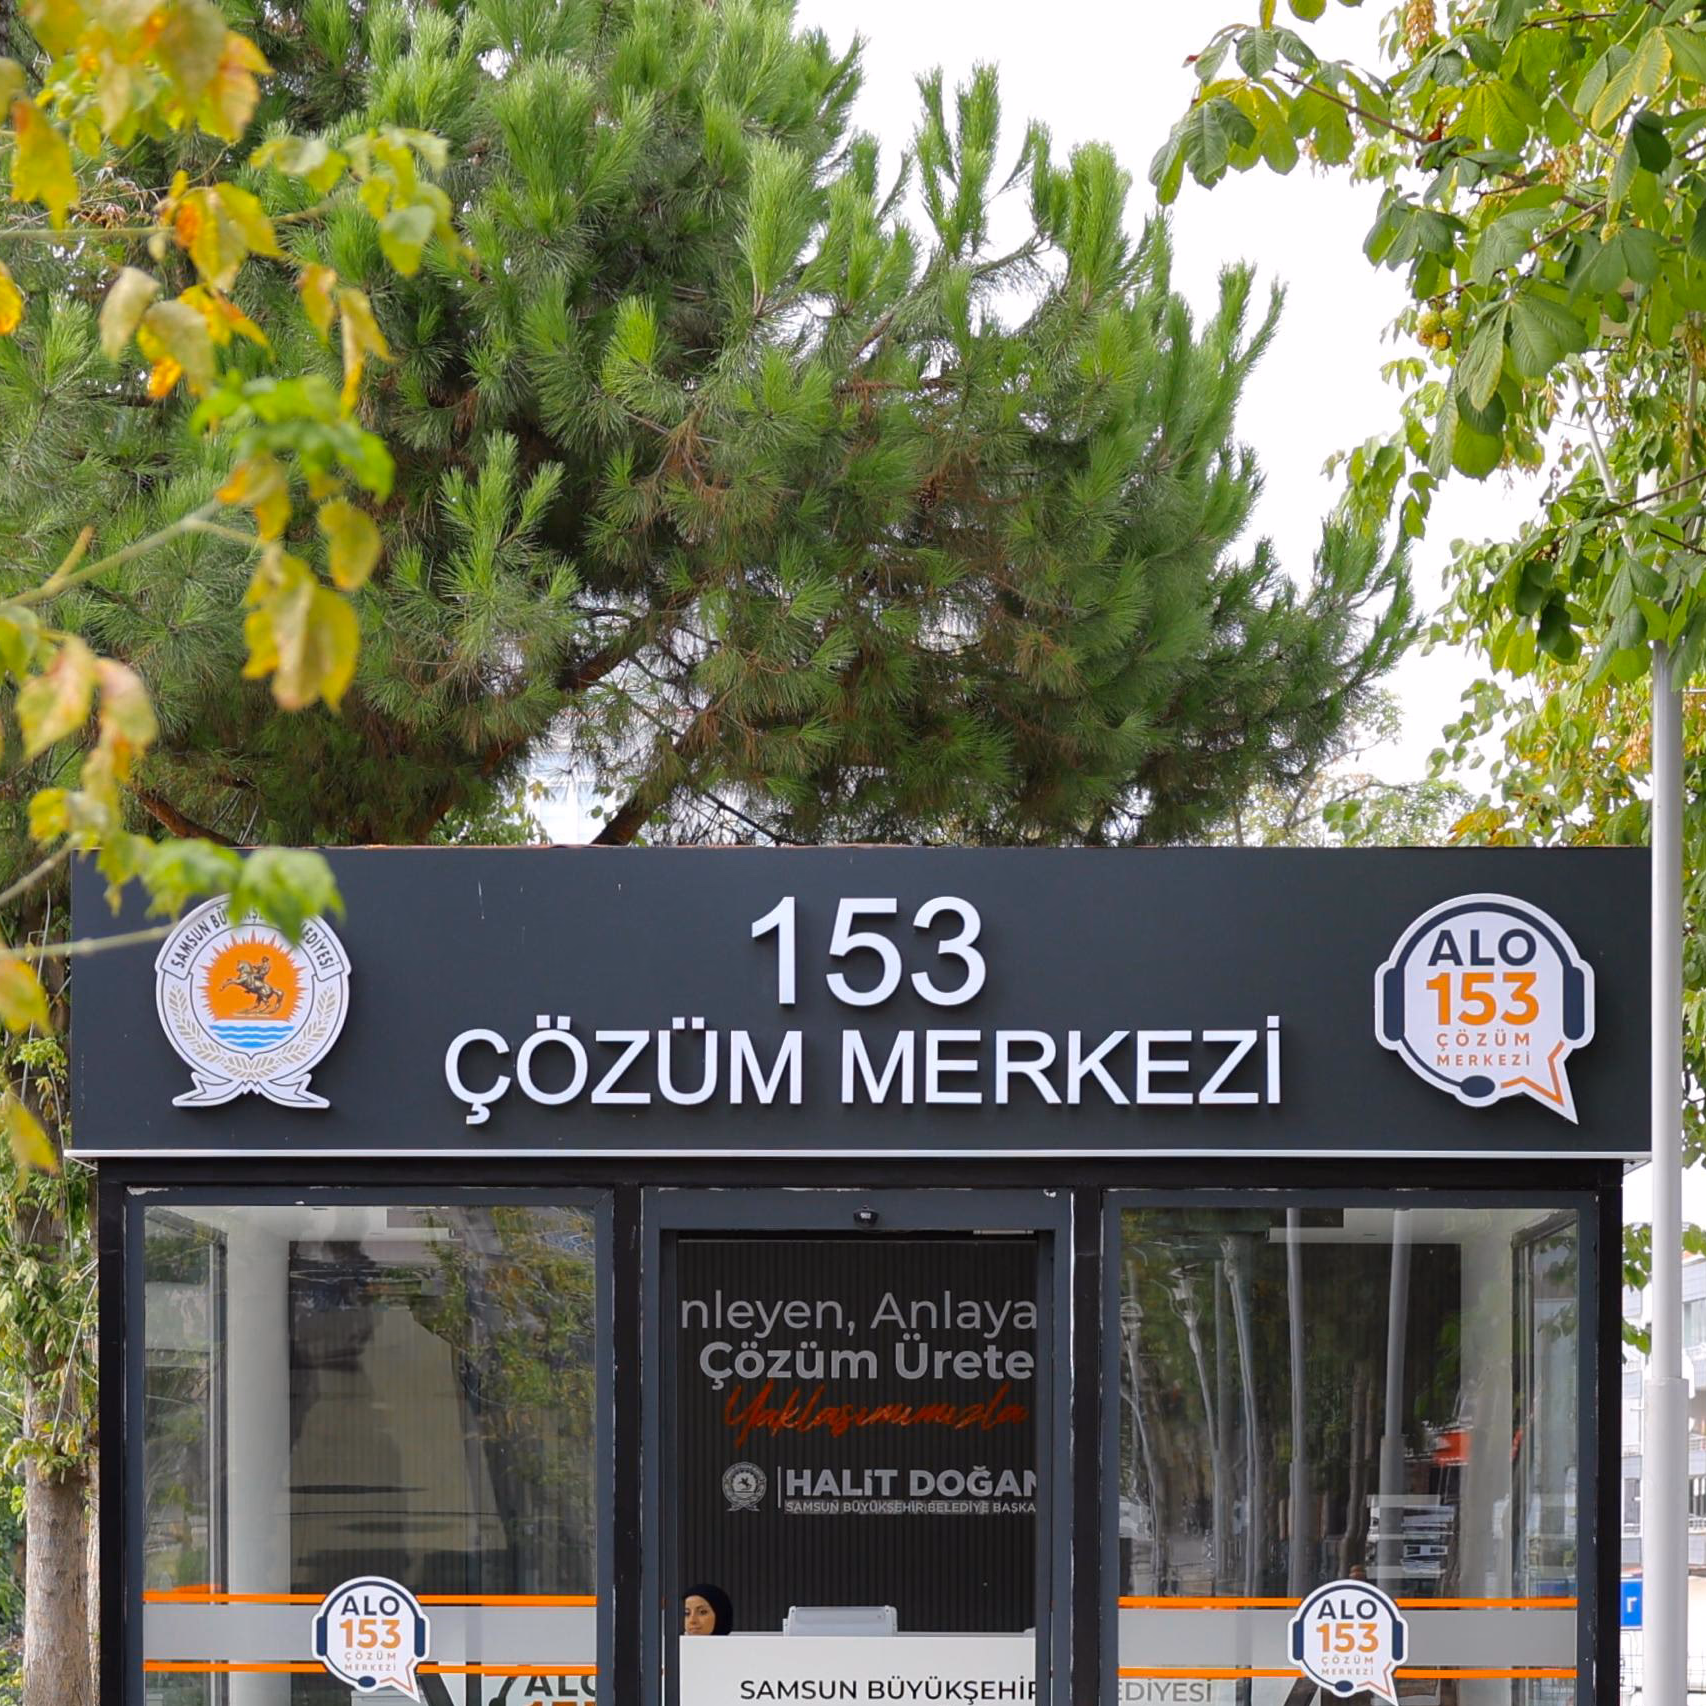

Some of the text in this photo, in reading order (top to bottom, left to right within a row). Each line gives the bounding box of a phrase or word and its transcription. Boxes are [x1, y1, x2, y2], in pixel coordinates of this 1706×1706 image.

[170, 920, 212, 969] SAMSUN
[751, 895, 988, 1007] 153
[1427, 928, 1538, 967] ALO
[1426, 972, 1540, 1026] 153
[1436, 1029, 1530, 1051] ÇÖZÜM
[444, 1014, 1283, 1126] ÇÖZÜM MERKEZİ
[1436, 1051, 1530, 1066] MERKEZİ
[699, 1341, 878, 1391] Çözüm
[785, 1500, 839, 1513] SAMSUN
[927, 1499, 989, 1513] BELEDİYE
[341, 1595, 400, 1616] ALO
[1317, 1599, 1378, 1620] ALO
[340, 1618, 402, 1649] 153
[1316, 1622, 1379, 1653] 153
[344, 1650, 396, 1662] ÇÖZÜM
[1321, 1654, 1373, 1666] ÇÖZÜM
[740, 1680, 857, 1700] SAMSUN
